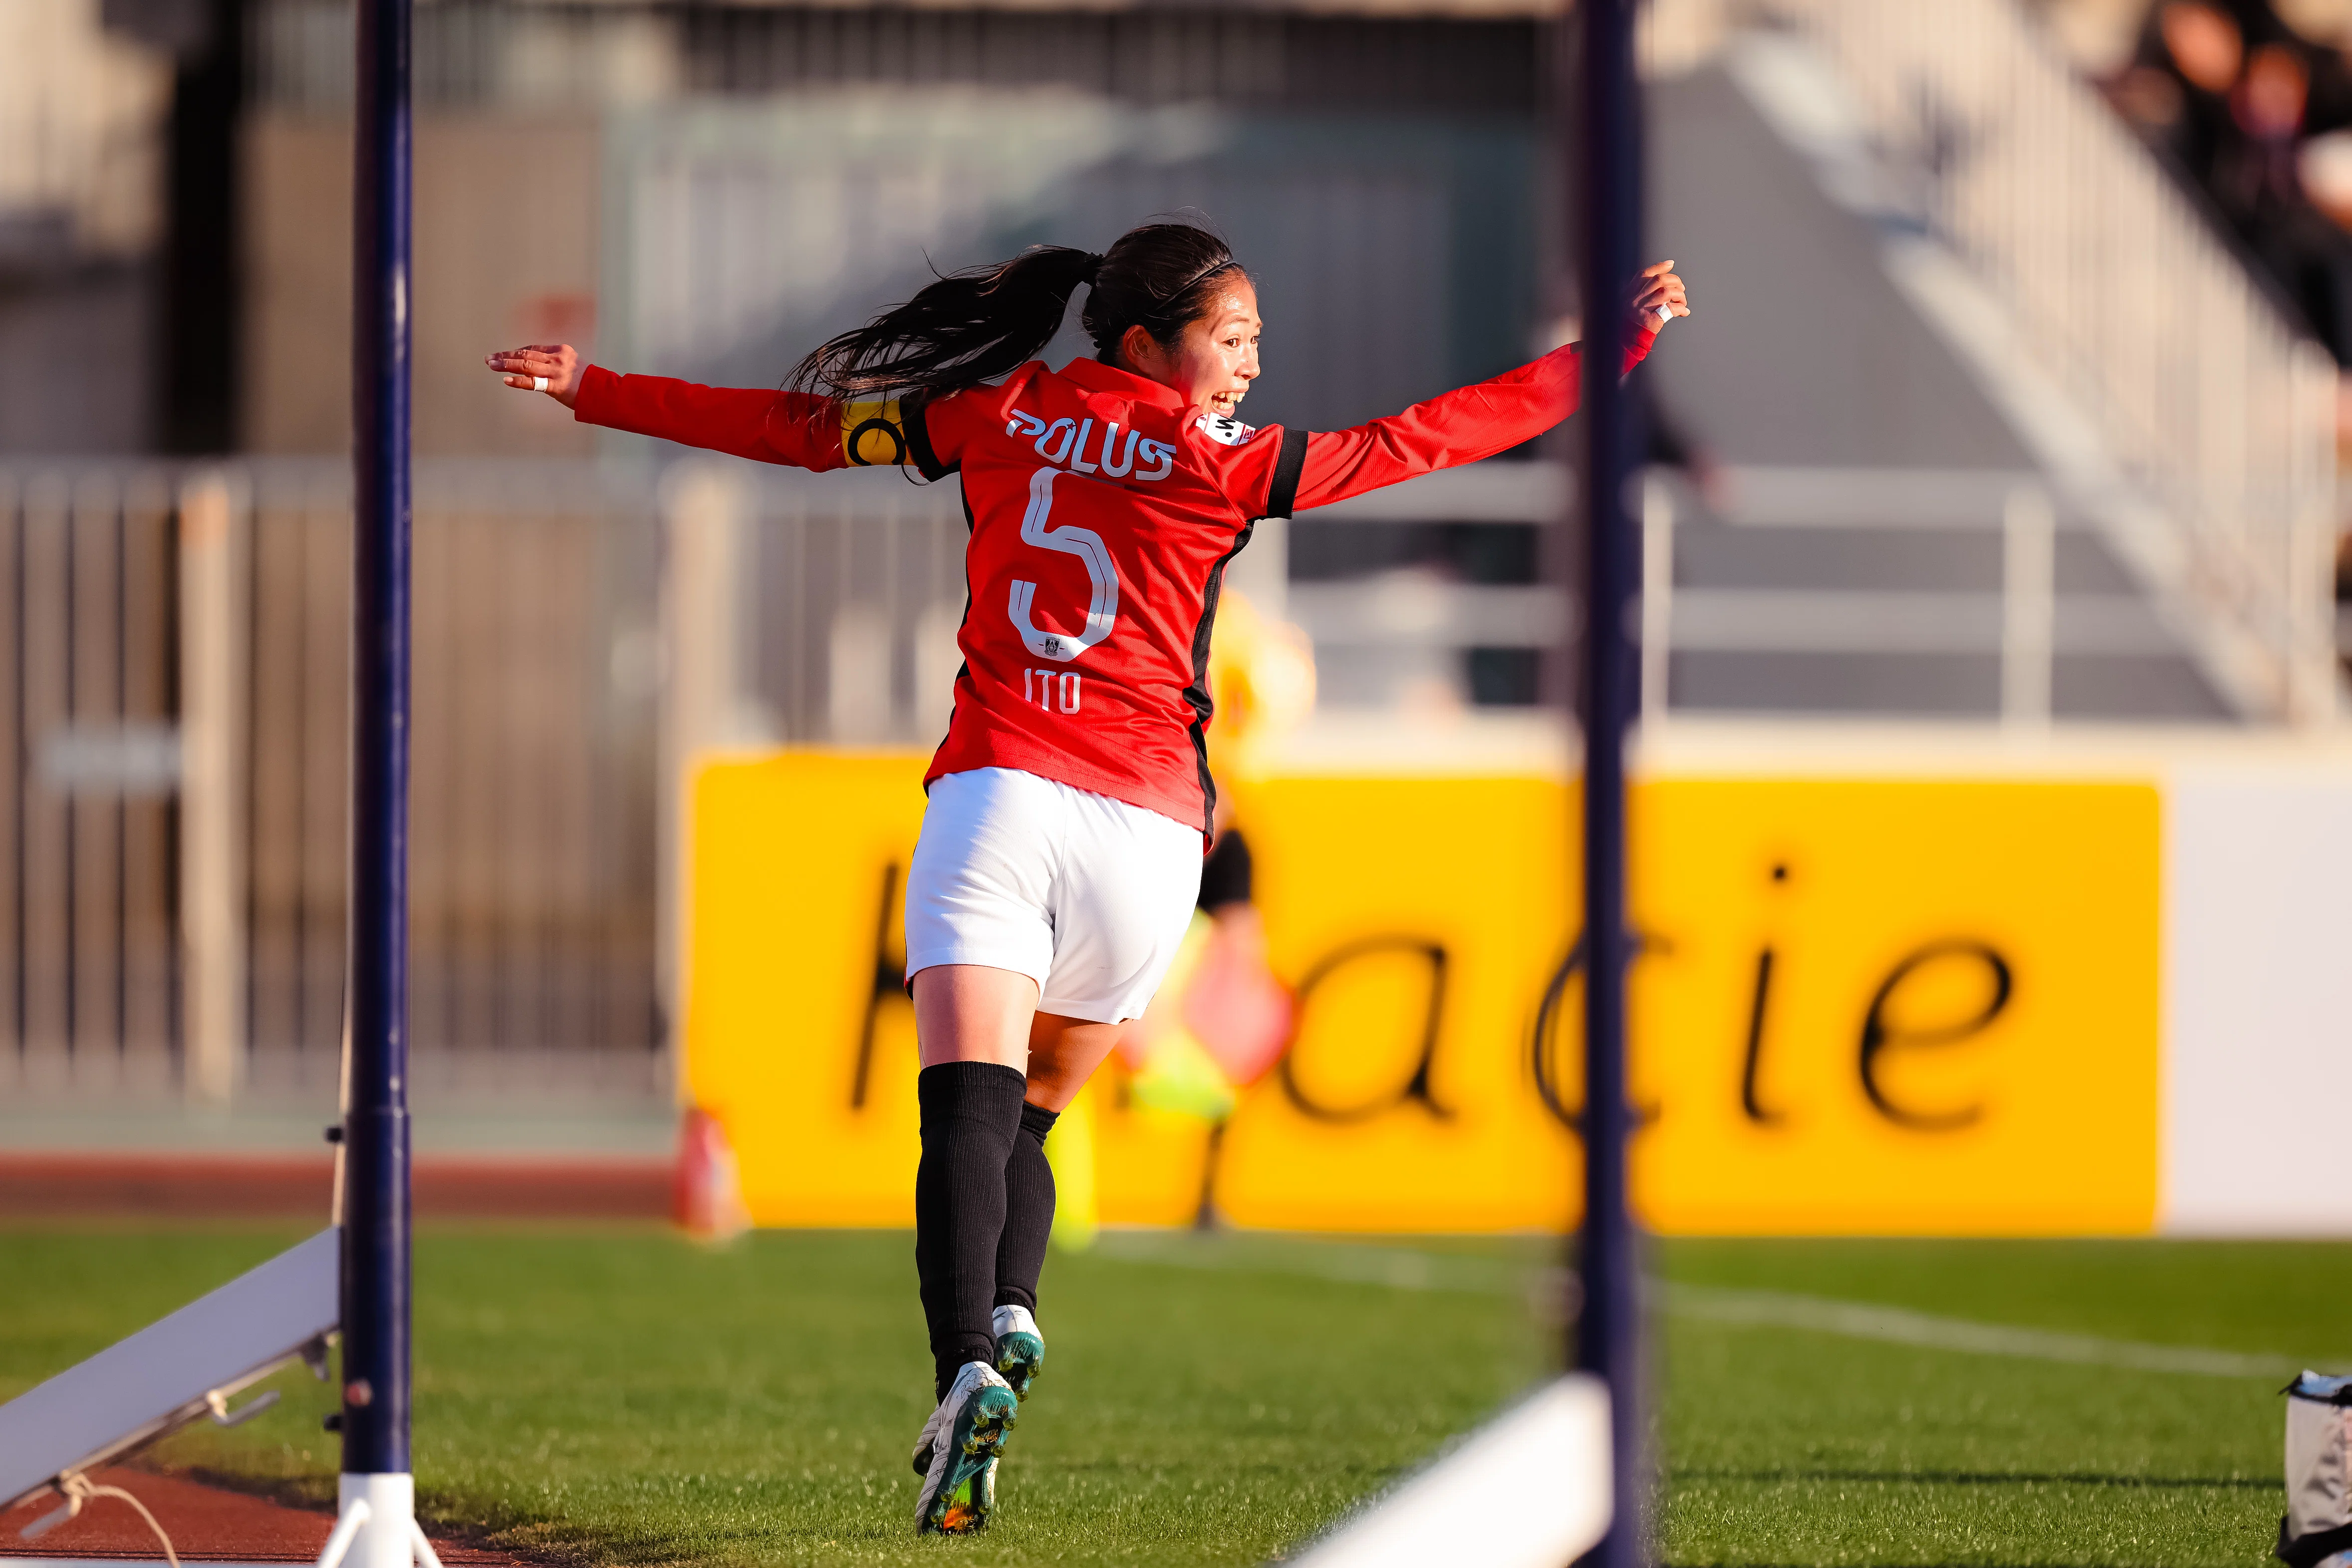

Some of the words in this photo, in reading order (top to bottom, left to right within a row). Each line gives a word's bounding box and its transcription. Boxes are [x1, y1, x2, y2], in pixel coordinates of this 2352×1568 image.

[1005, 408, 1178, 482] POLUS
[1008, 466, 1119, 663] 5
[1025, 668, 1081, 715] ITO
[849, 857, 2013, 1134] acie
